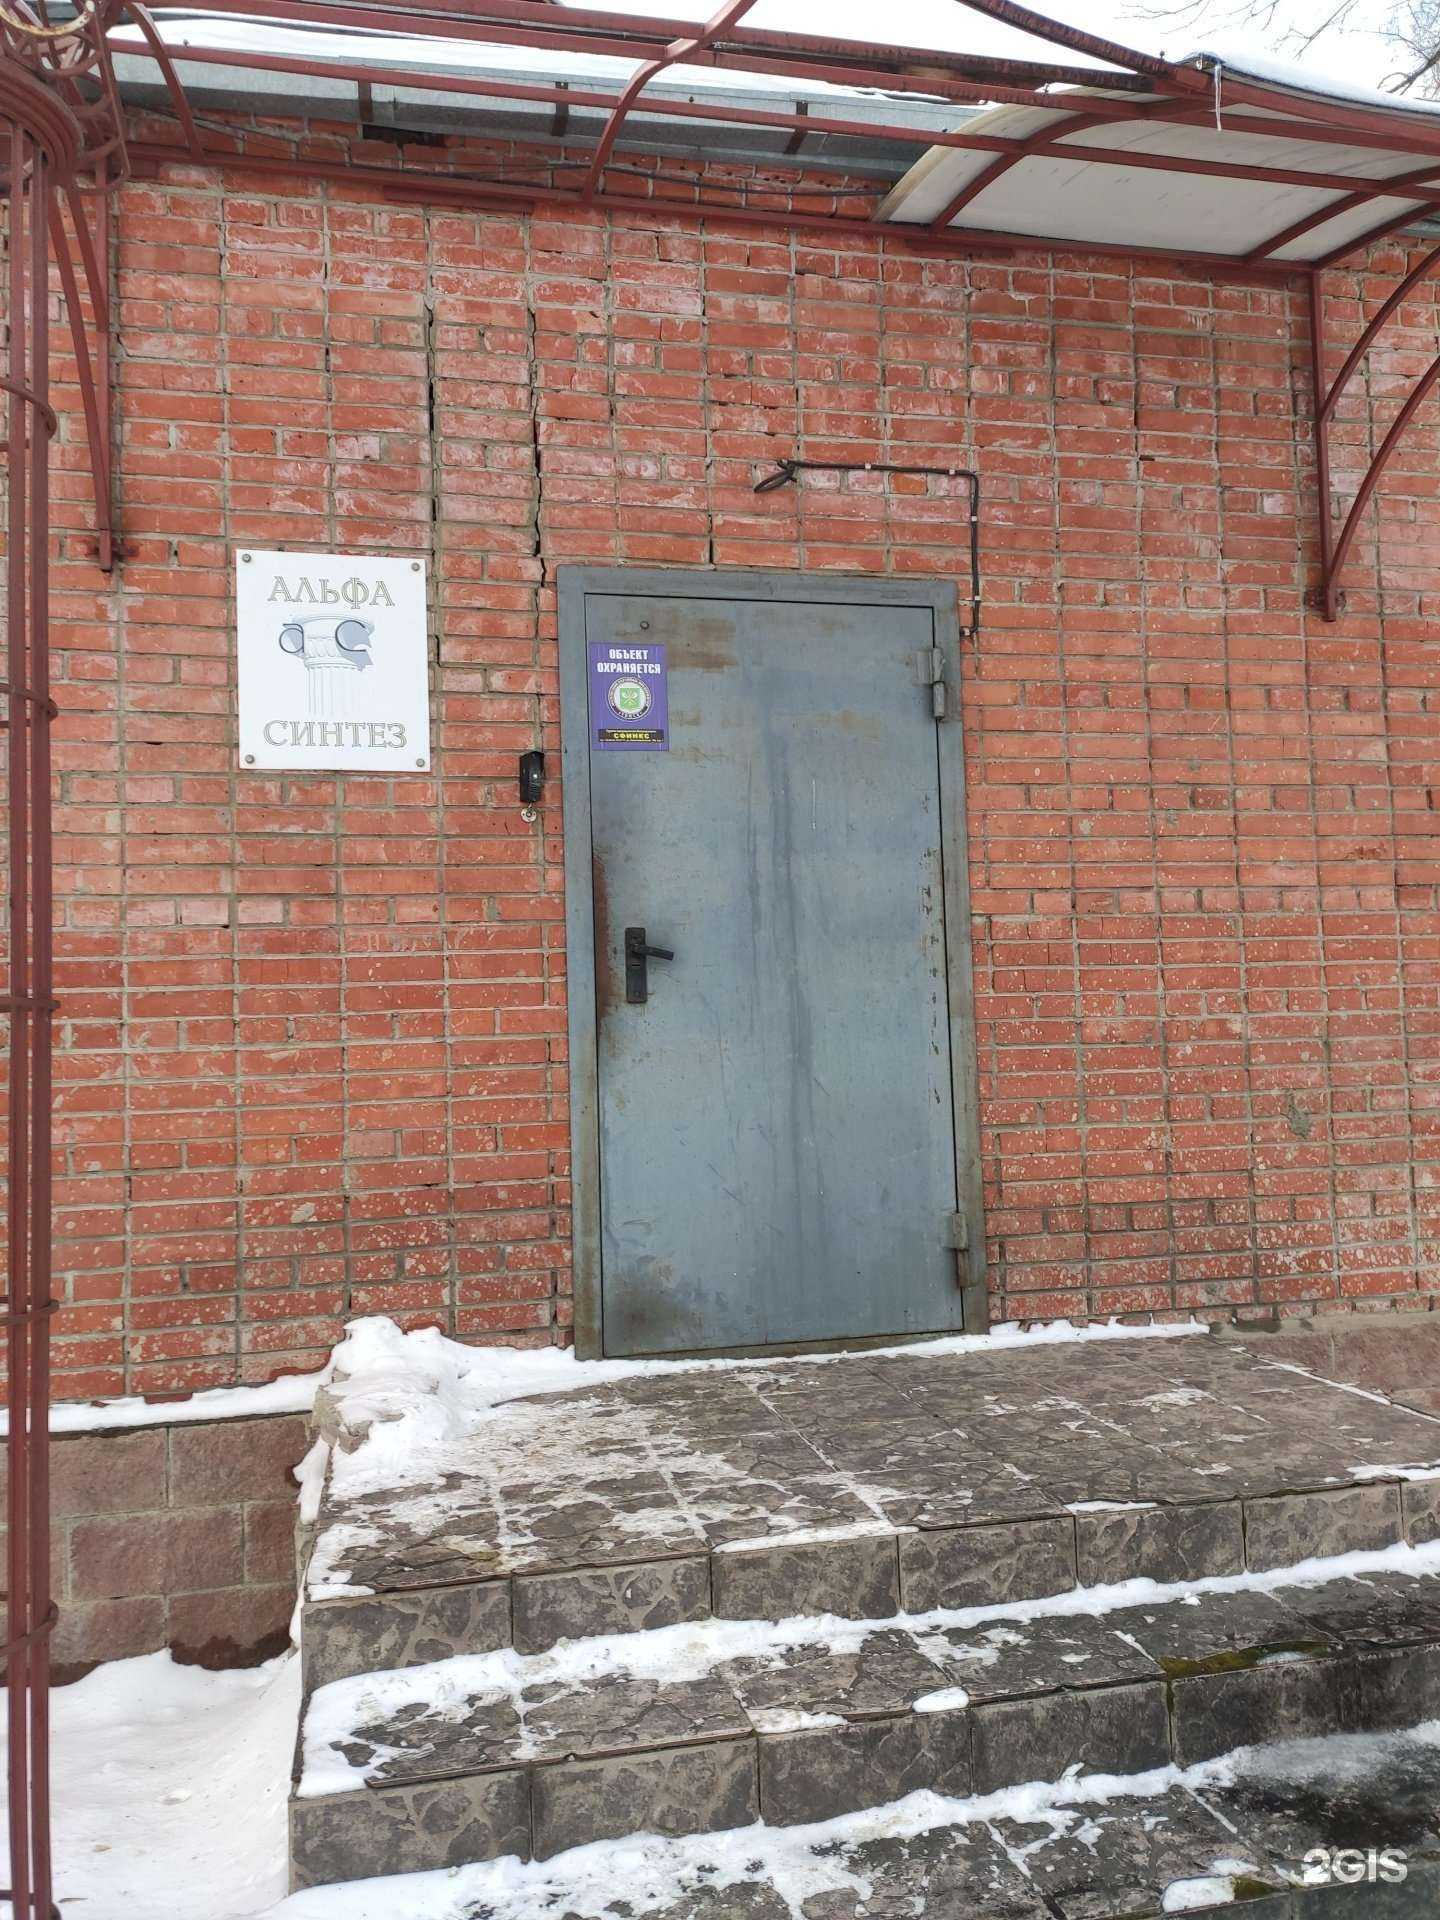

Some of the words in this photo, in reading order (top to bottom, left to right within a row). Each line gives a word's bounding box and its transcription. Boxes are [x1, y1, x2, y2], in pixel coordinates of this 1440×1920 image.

[267, 575, 396, 610] АЛЬФА
[609, 649, 649, 660] ОБЪЕКТ
[597, 662, 661, 674] ОХРАНЯЕТСЯ
[263, 719, 408, 749] СИНТЕЗ
